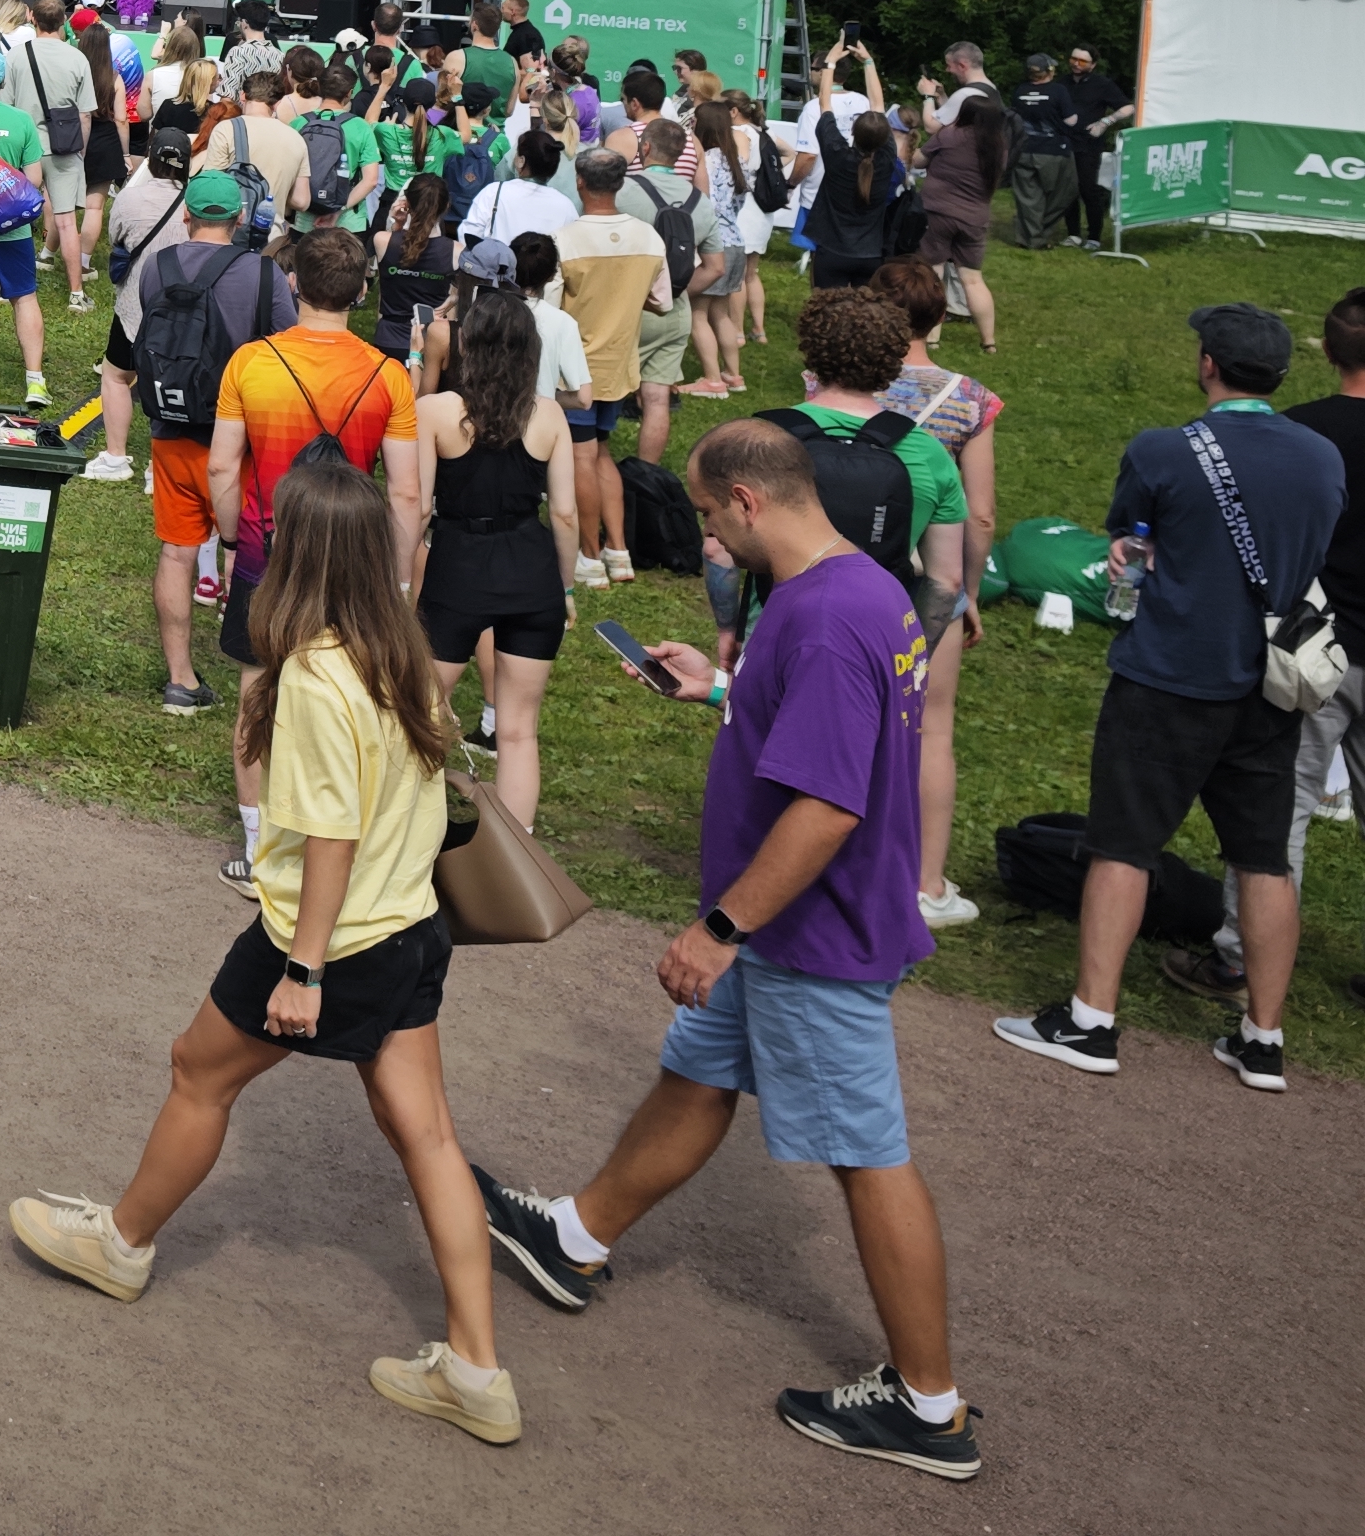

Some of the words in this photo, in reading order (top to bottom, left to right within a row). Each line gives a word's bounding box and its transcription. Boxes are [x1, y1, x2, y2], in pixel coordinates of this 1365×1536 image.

[577, 14, 651, 31] лемана
[655, 18, 687, 33] тех
[737, 18, 747, 31] 5
[735, 53, 745, 66] 0
[604, 70, 622, 83] 30
[1147, 140, 1208, 175] RUNIT
[871, 505, 887, 543] THULE
